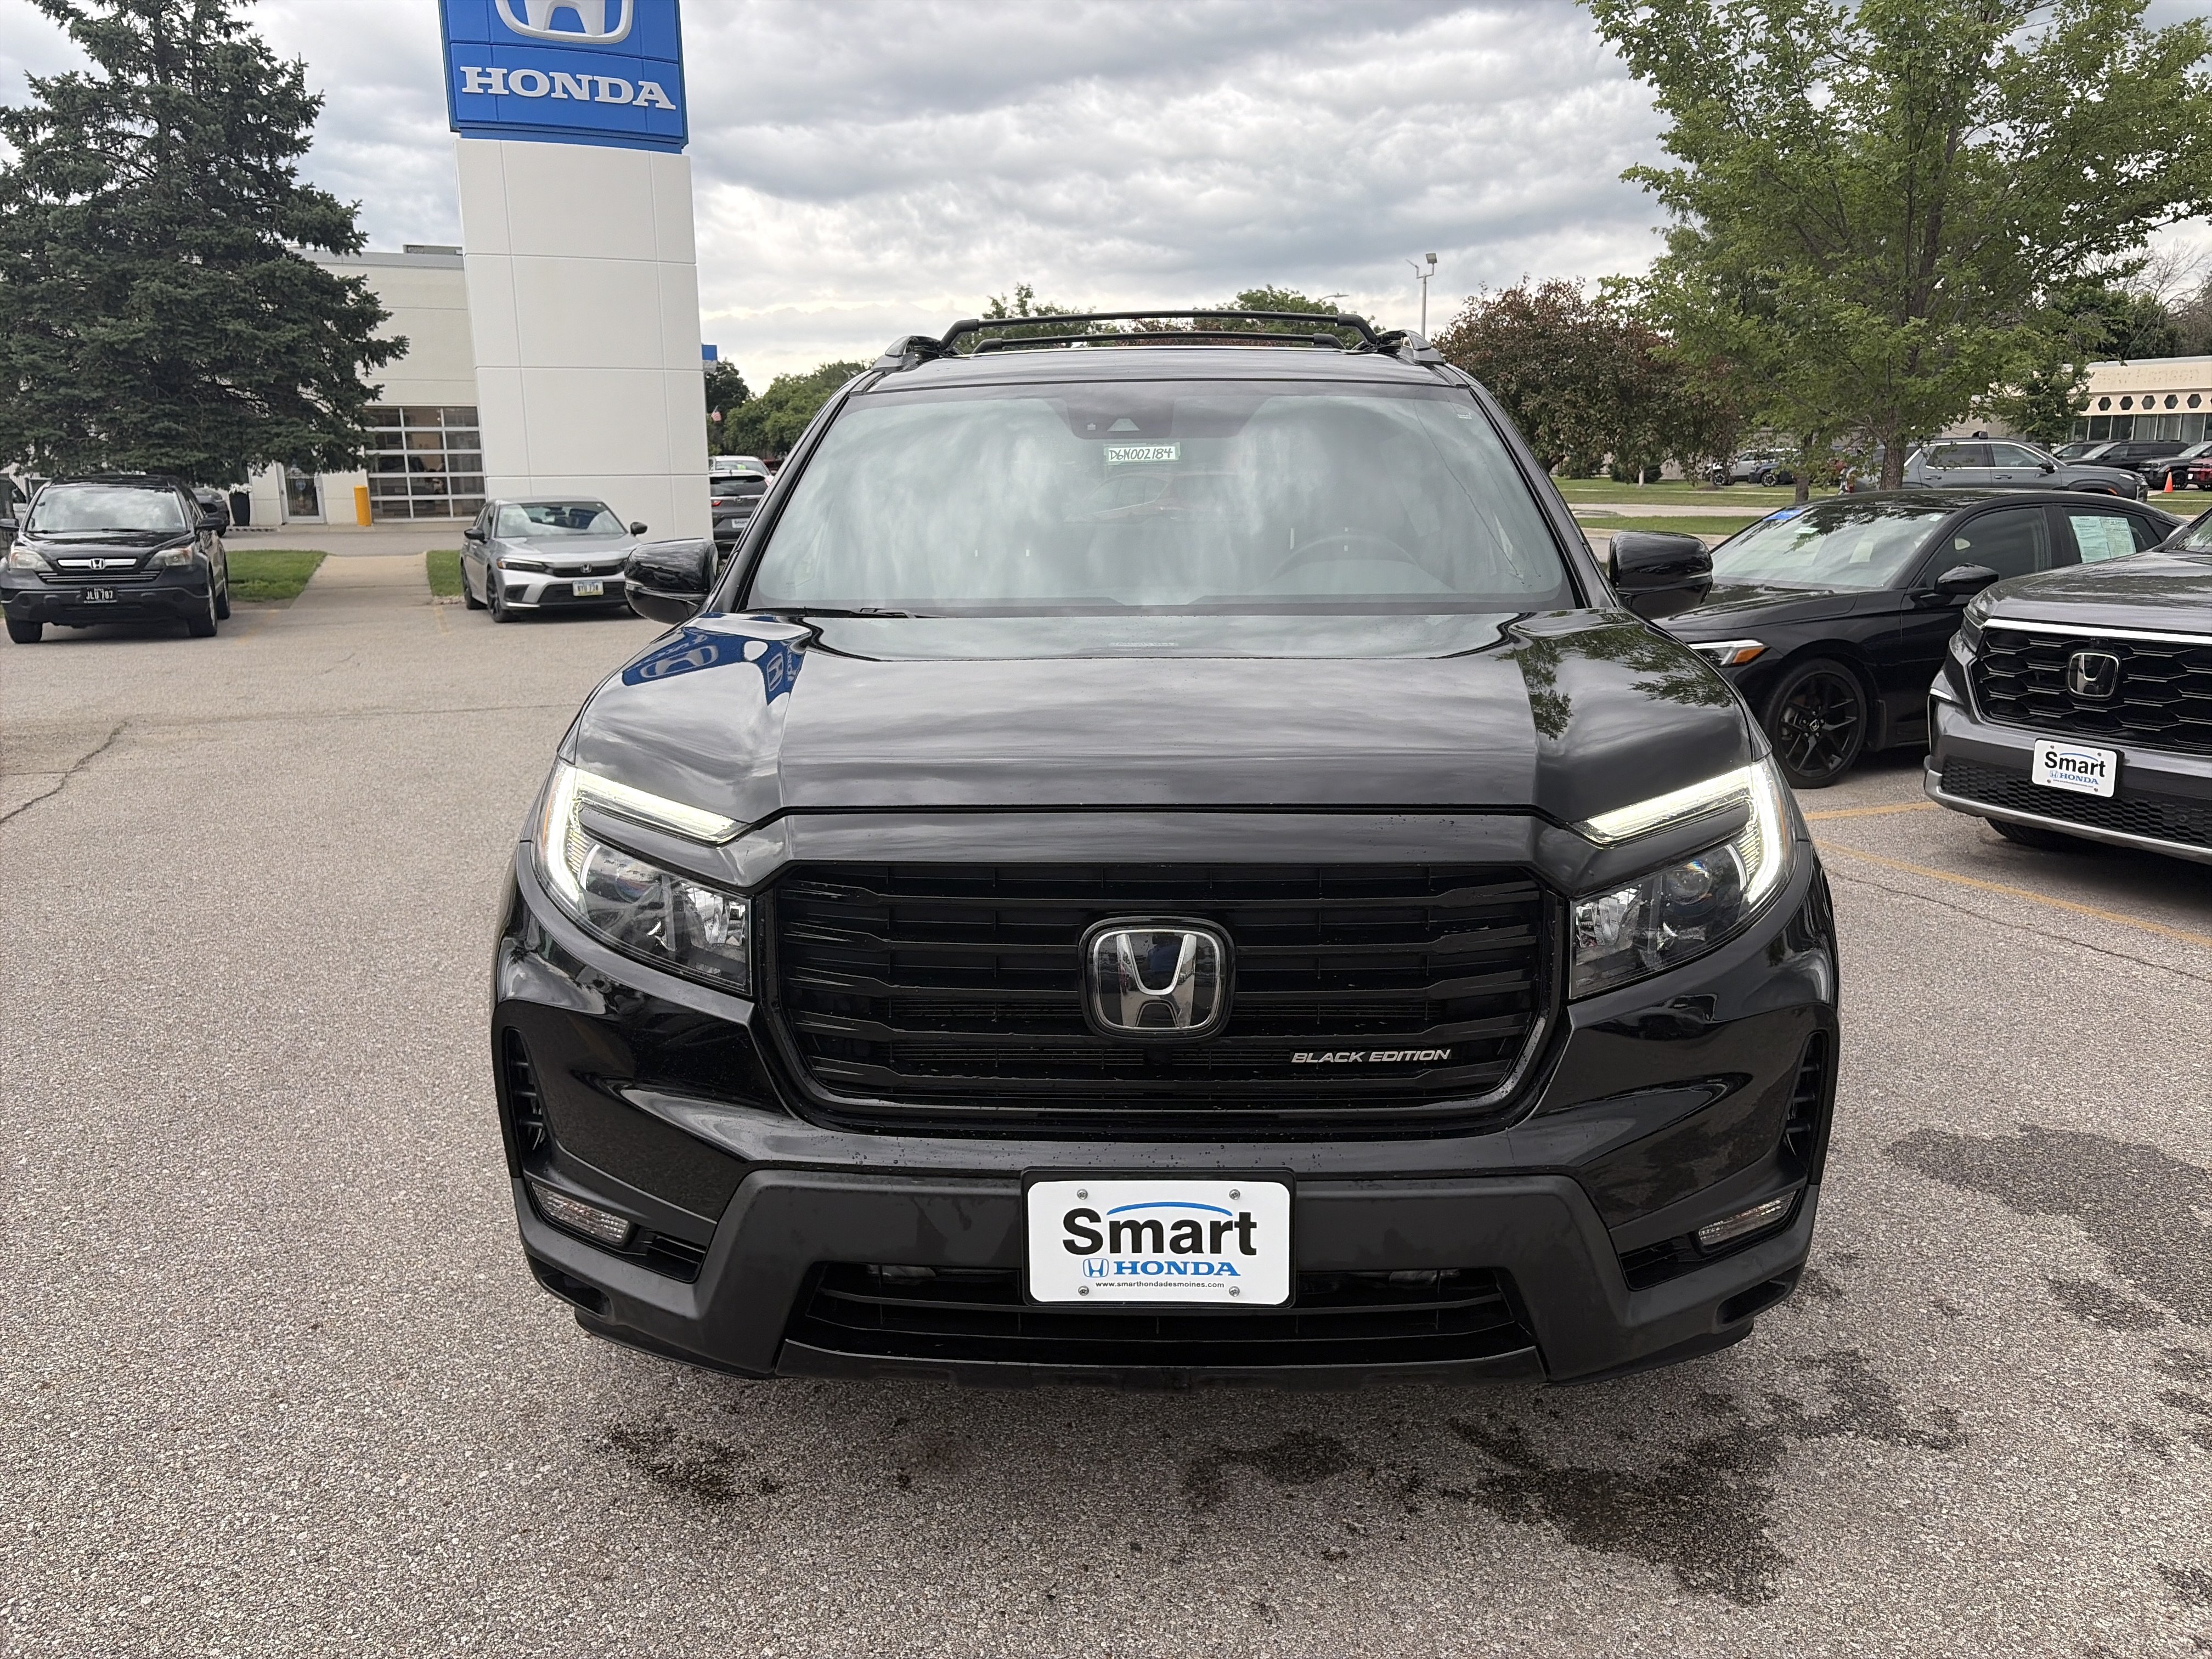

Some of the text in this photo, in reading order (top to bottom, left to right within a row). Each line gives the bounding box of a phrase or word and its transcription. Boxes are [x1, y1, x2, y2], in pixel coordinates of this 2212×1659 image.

[460, 66, 676, 110] HONDA
[1109, 447, 1173, 460] D6N002184
[86, 591, 99, 600] JLU
[2044, 751, 2106, 777] Smart
[2059, 772, 2098, 785] HONDA
[1291, 1049, 1451, 1063] BLACK EDITION
[1062, 1207, 1257, 1256] Smart
[1114, 1261, 1241, 1277] HONDA
